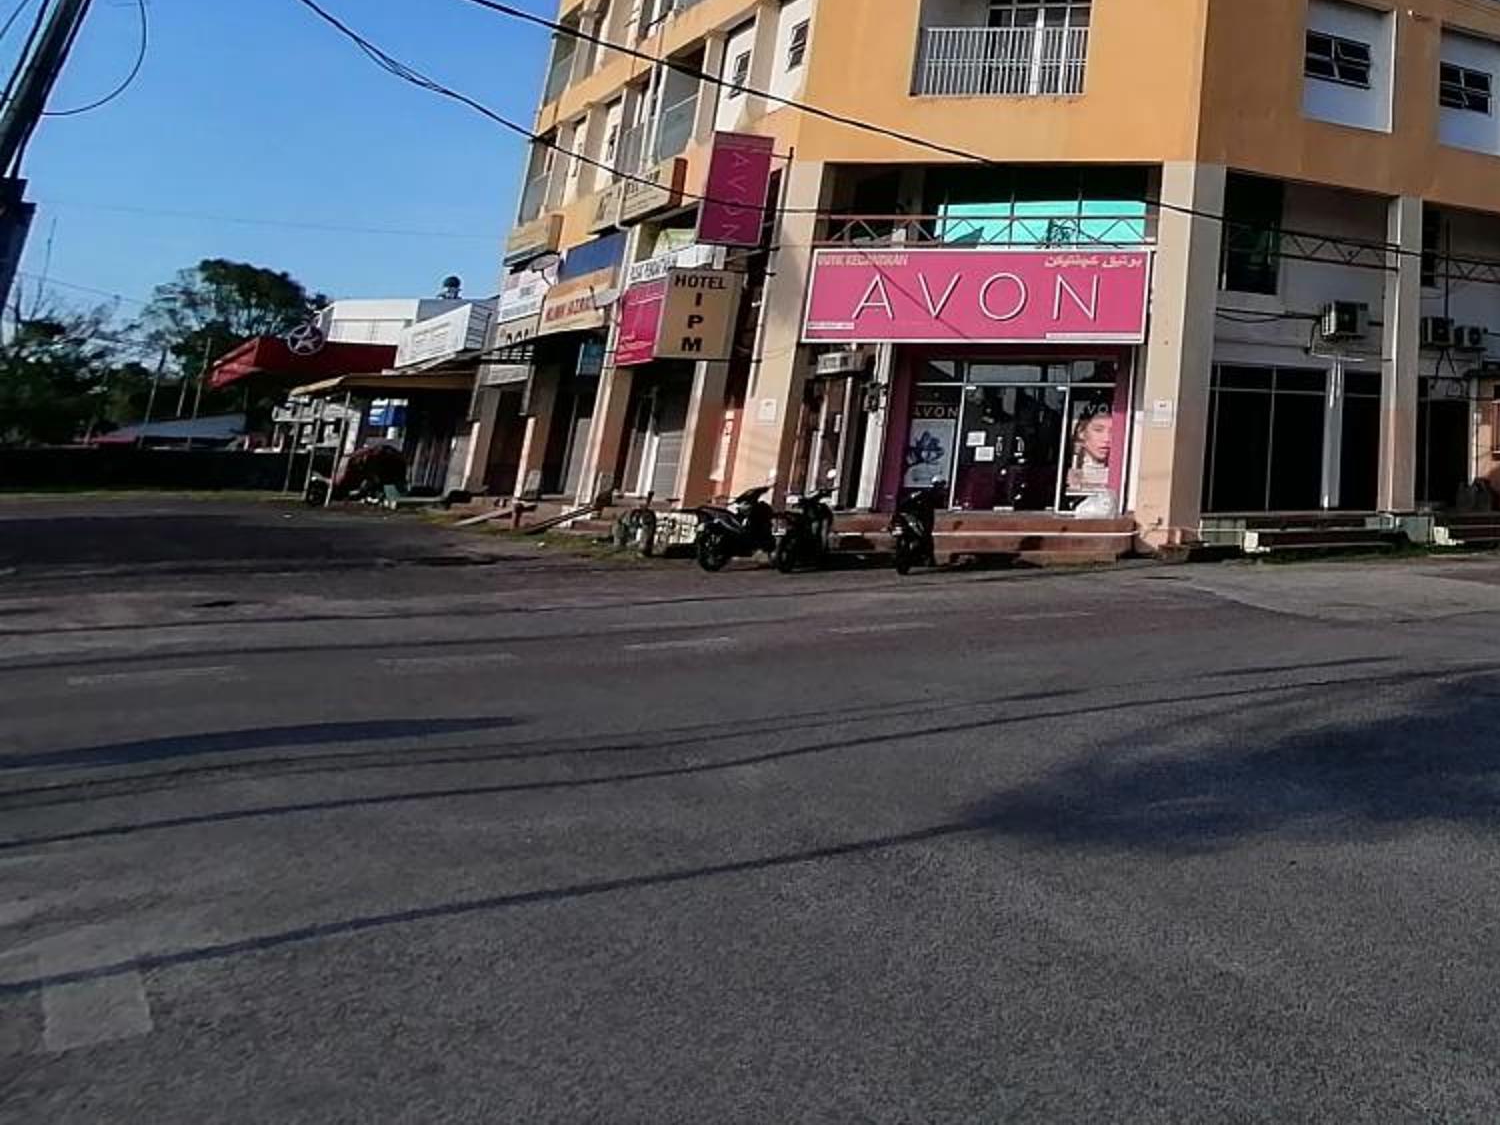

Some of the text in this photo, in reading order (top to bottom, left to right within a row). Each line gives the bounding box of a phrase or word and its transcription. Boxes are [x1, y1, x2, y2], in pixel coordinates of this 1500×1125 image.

[720, 151, 750, 238] AVON
[674, 274, 727, 290] HOTEL
[851, 272, 1100, 321] AVON
